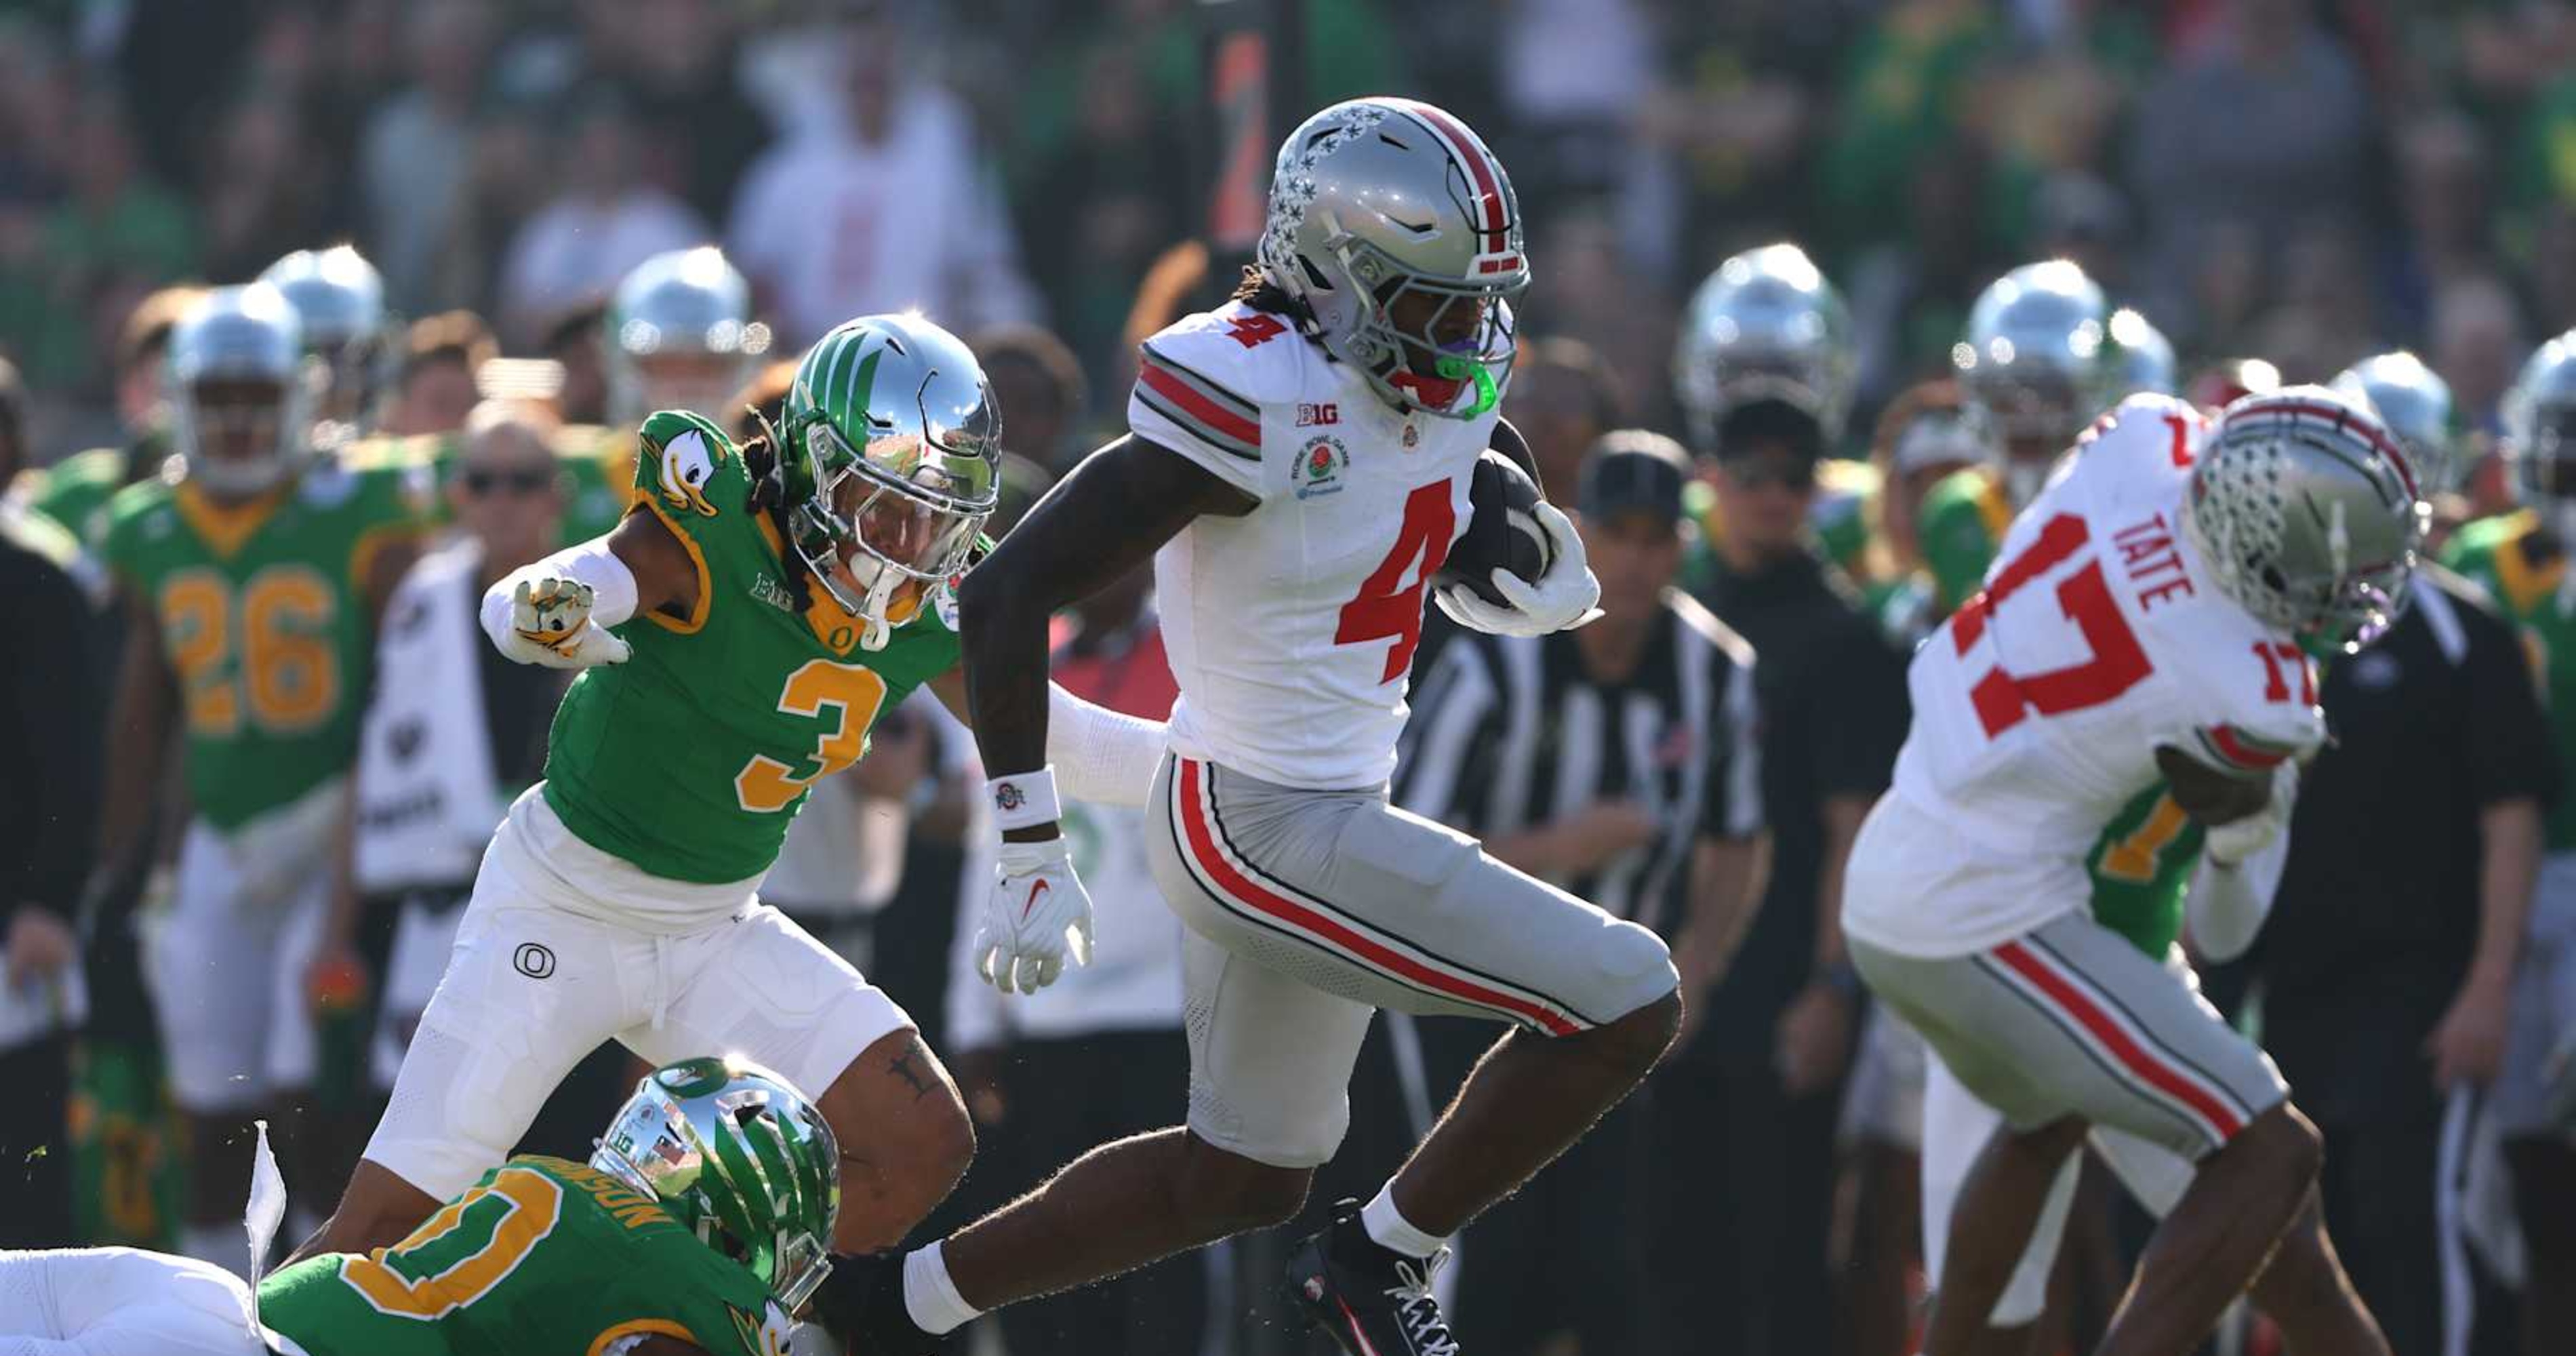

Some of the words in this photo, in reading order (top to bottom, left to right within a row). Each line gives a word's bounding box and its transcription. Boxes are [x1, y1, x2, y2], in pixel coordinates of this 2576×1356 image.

[1225, 314, 1288, 350] 4
[1334, 477, 1456, 686] 4
[1951, 511, 2156, 741] 17
[2112, 511, 2195, 614] TATE
[160, 567, 340, 736] 26
[733, 658, 888, 812] 3
[513, 942, 556, 979] O
